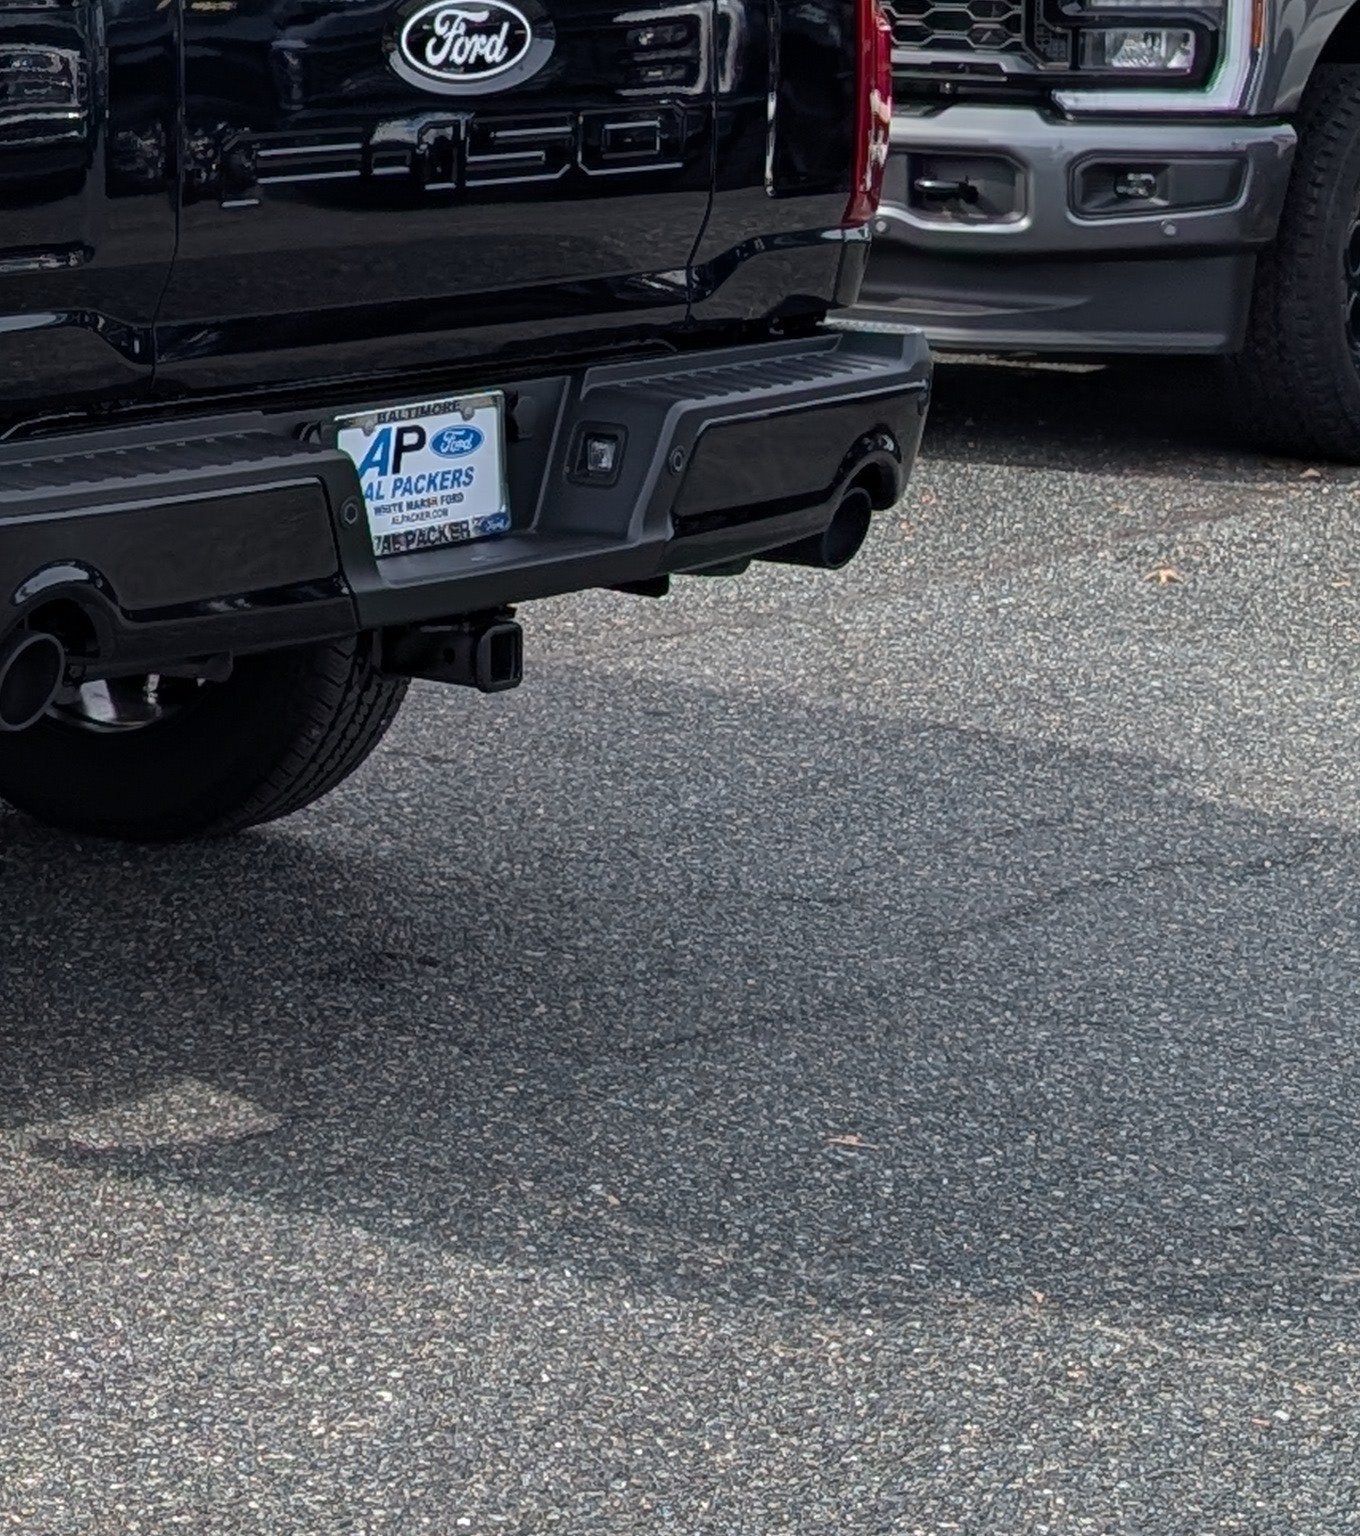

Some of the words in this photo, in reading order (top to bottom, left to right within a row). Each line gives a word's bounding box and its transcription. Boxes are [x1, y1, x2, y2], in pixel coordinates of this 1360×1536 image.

[425, 9, 509, 66] Ford
[377, 399, 461, 424] BALTIMORE
[358, 424, 427, 480] AP
[364, 481, 385, 502] AL
[391, 466, 475, 499] PACKERS
[440, 491, 465, 505] FORD
